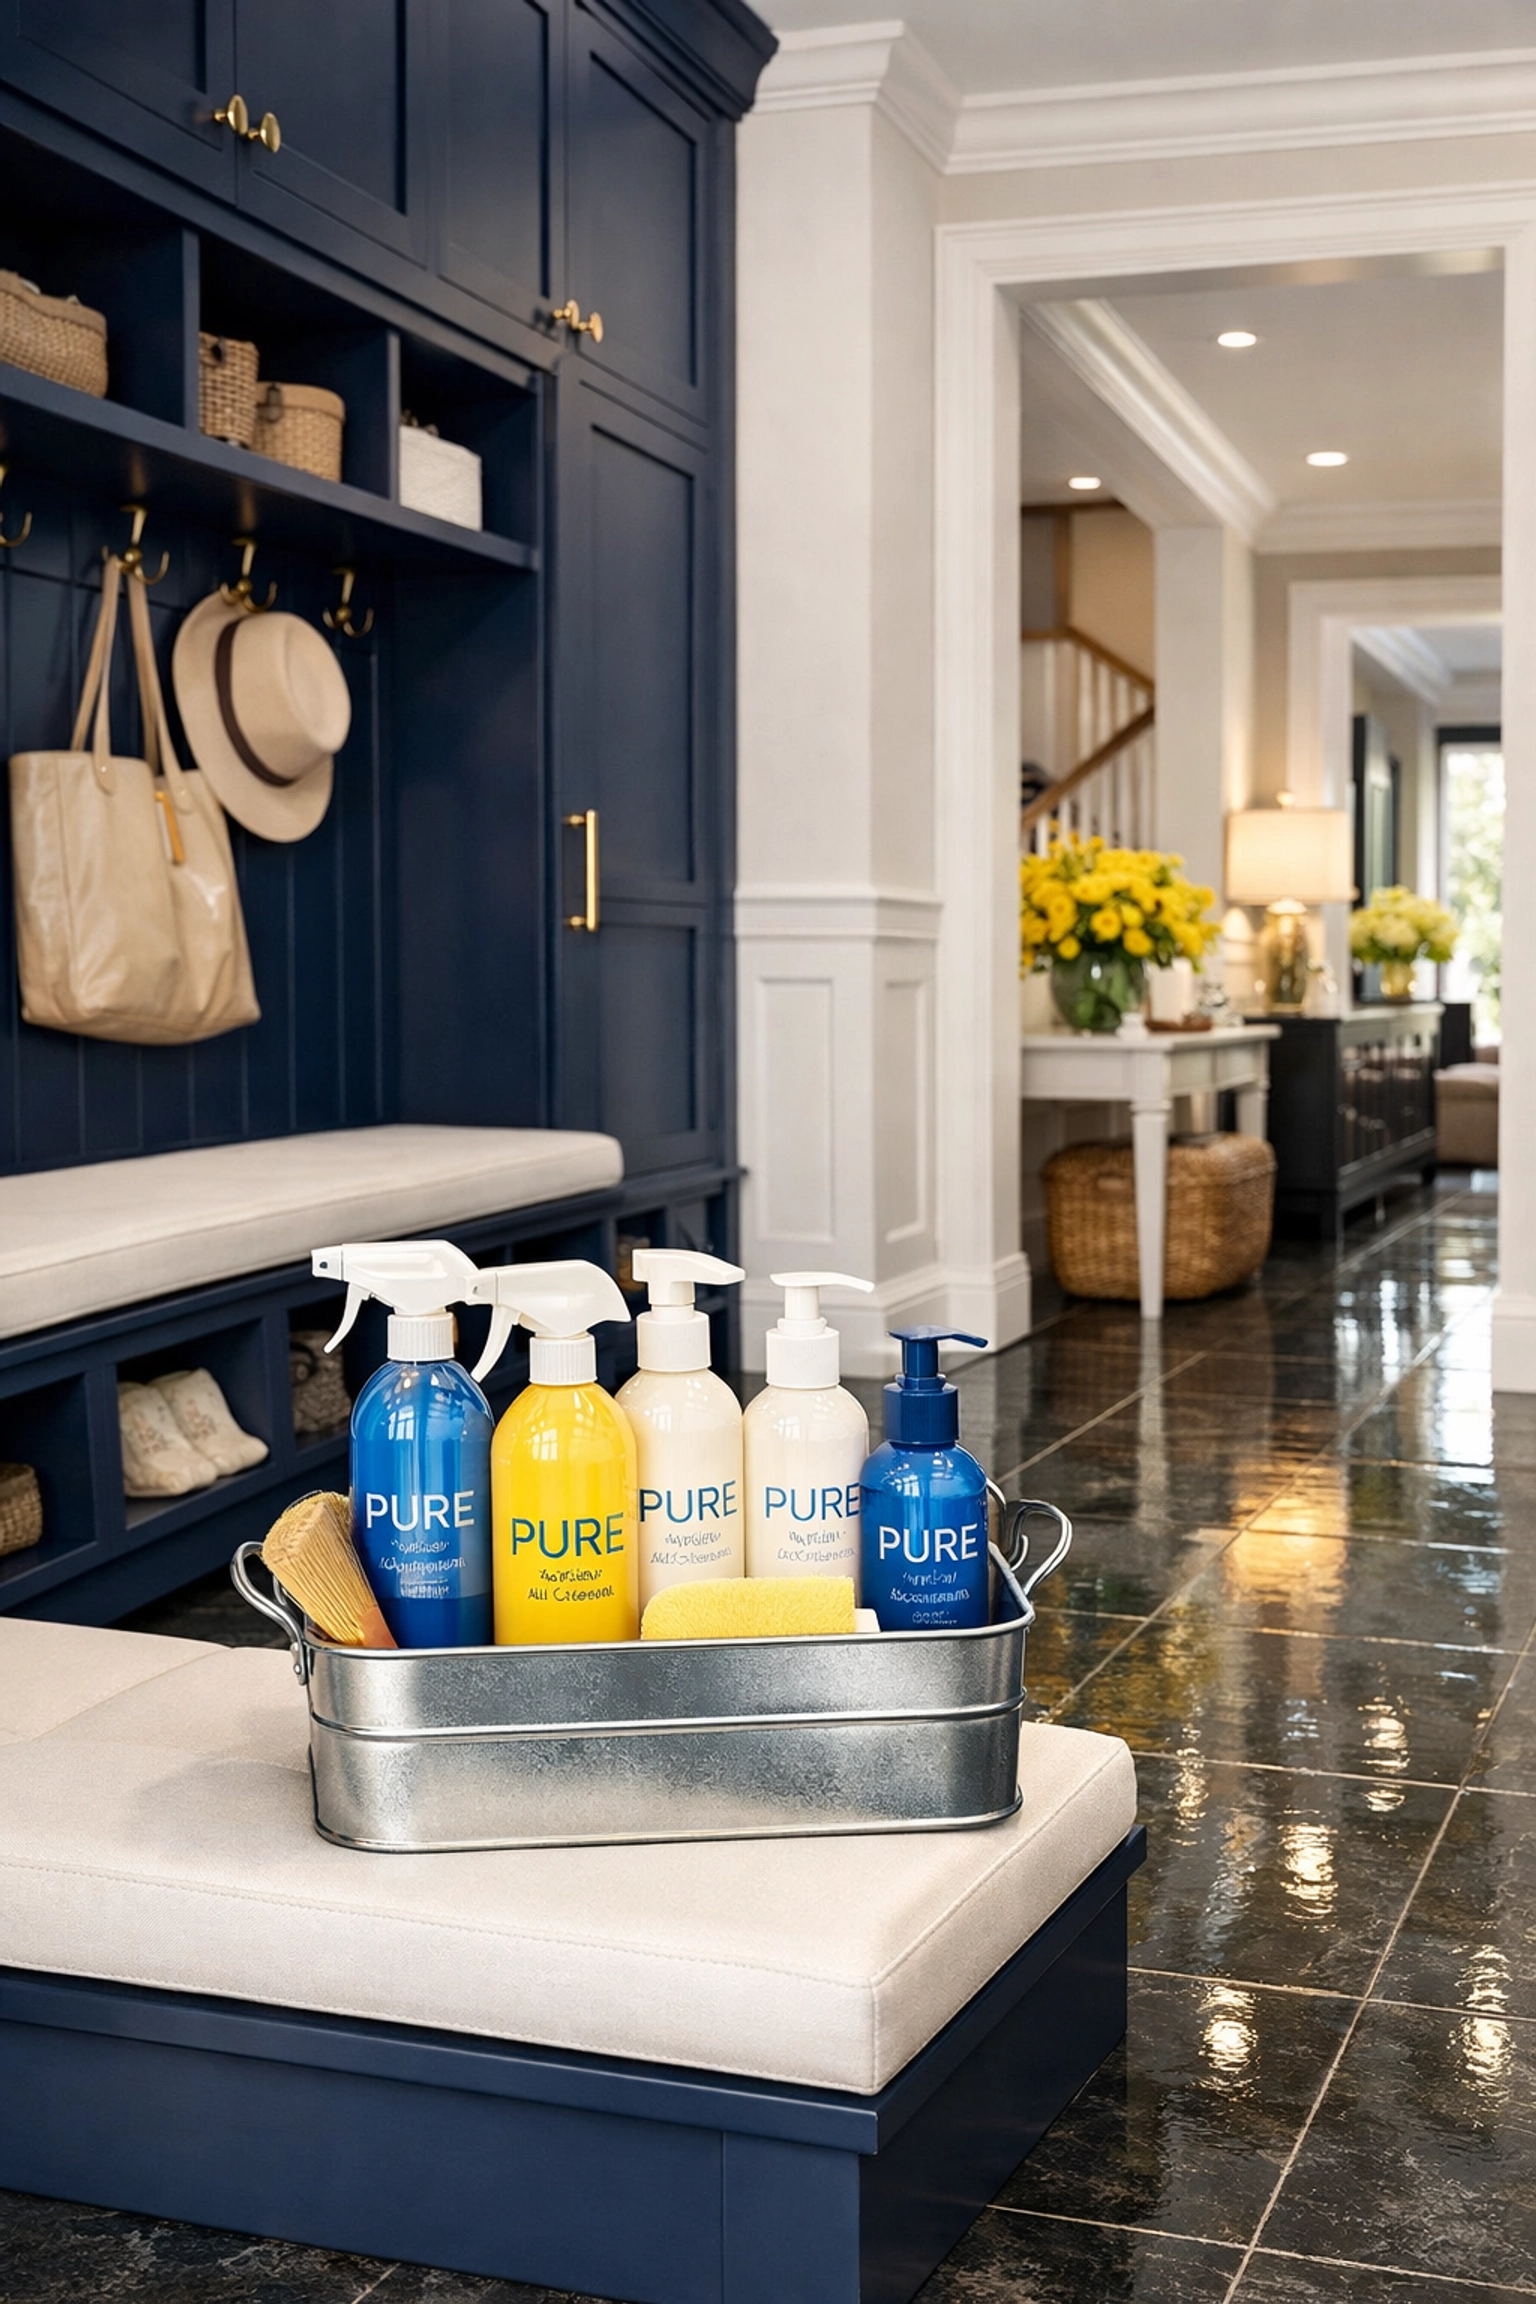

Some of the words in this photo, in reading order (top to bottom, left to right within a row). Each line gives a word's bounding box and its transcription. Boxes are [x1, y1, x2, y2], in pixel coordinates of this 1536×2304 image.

[365, 1489, 475, 1531] PURE
[638, 1479, 738, 1523] PURE
[765, 1481, 860, 1522] PURE
[511, 1511, 625, 1559] PURE
[878, 1522, 978, 1563] PURE
